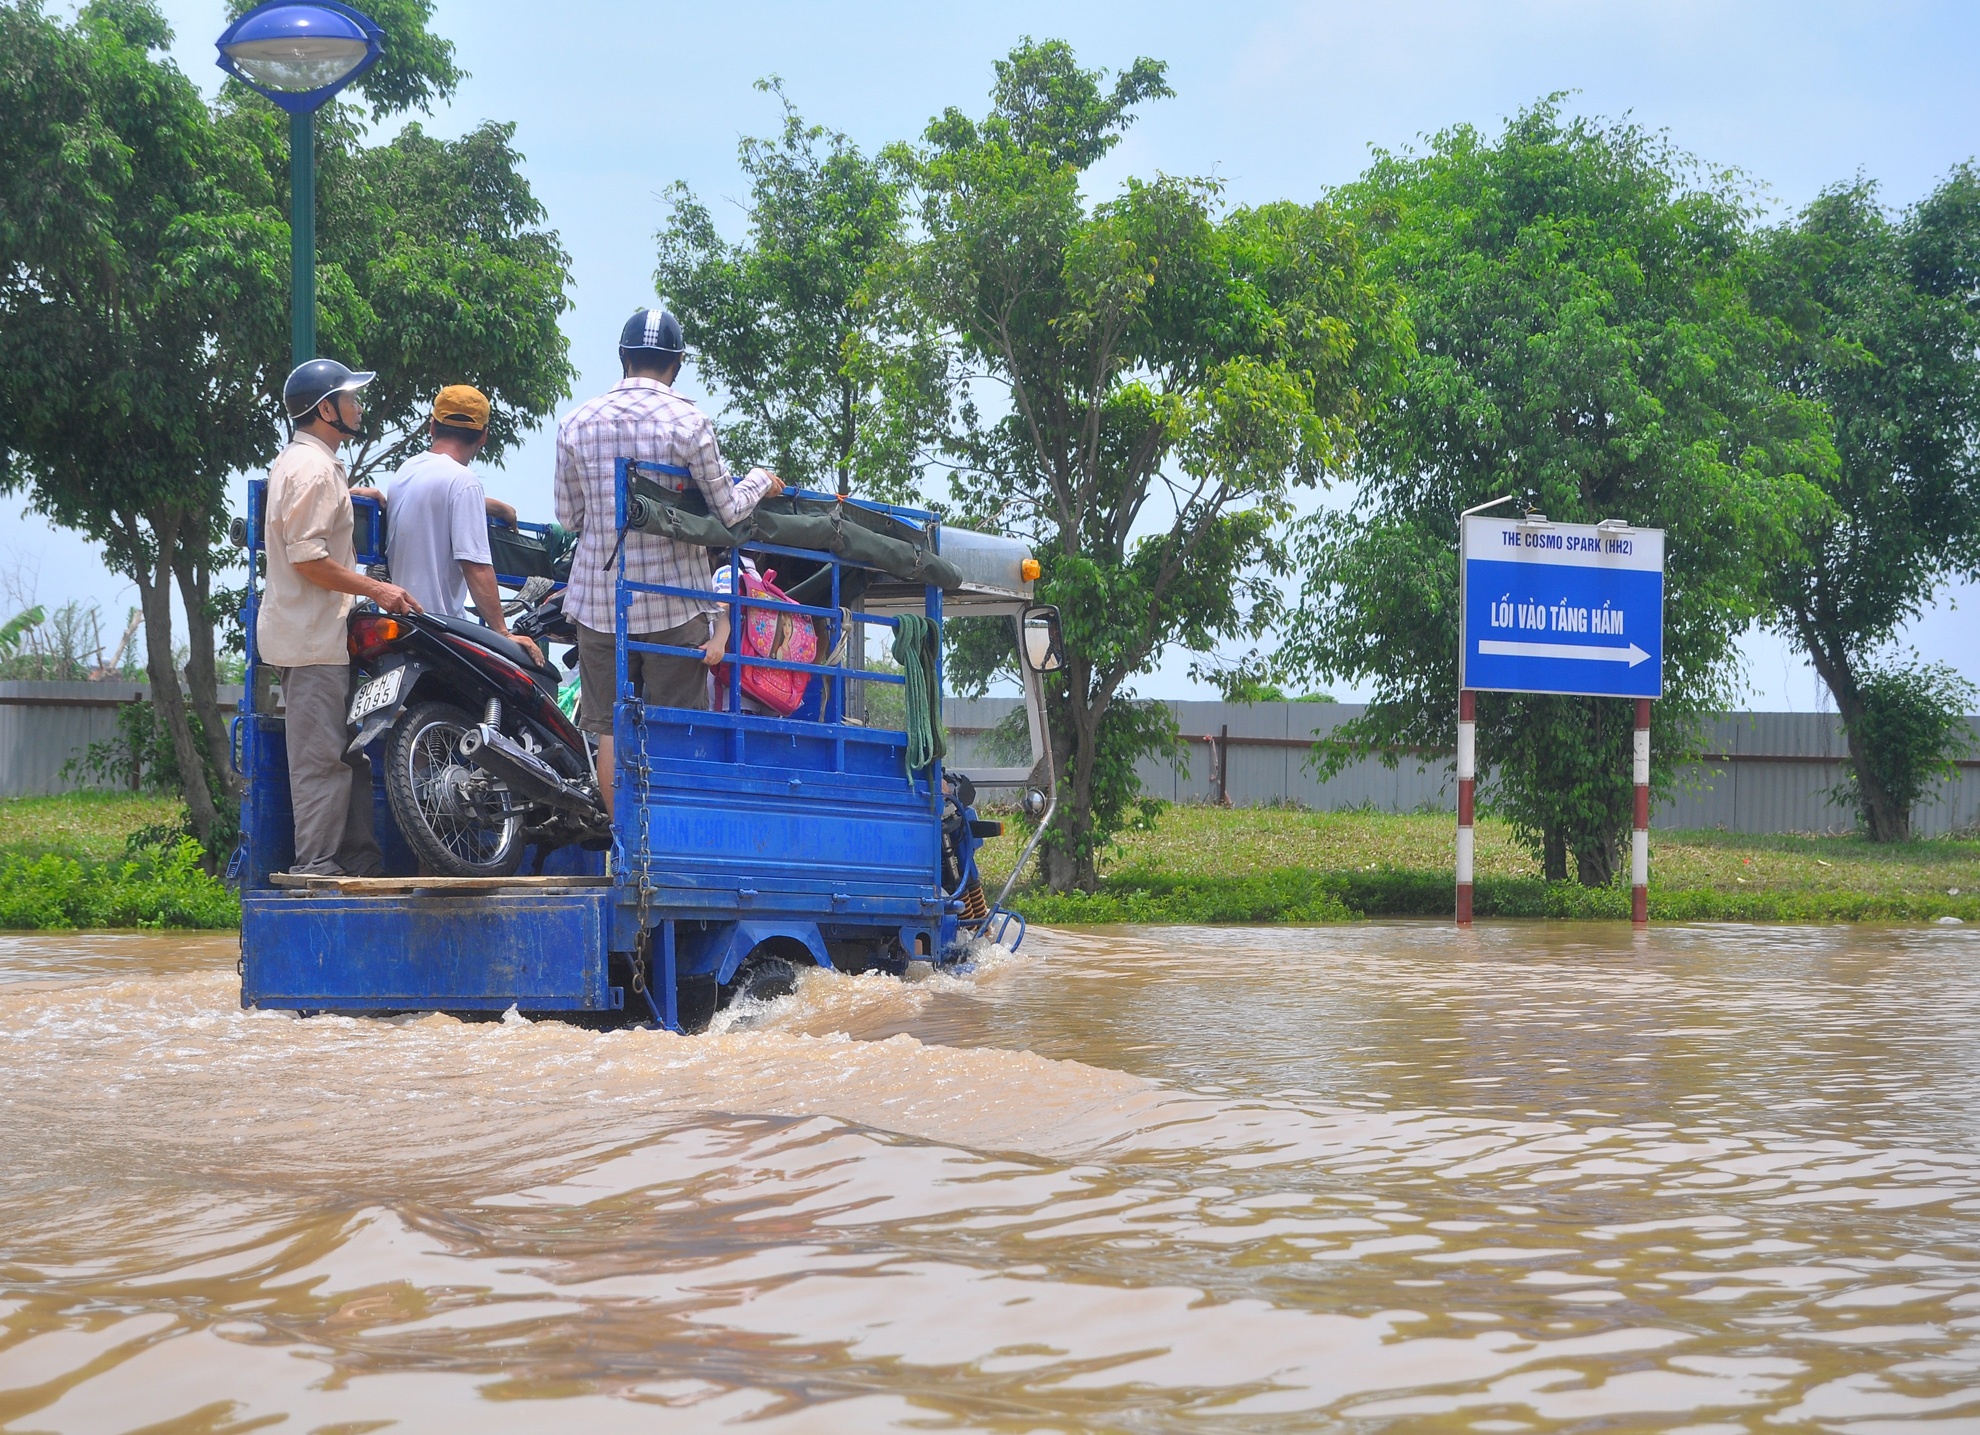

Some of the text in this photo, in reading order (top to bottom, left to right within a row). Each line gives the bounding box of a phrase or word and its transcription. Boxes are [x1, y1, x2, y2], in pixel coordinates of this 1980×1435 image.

[1502, 531, 1633, 556] THE COSMO SPARK (HH2)
[1491, 593, 1624, 635] LỐI VÀO TẦNG HẦM
[355, 688, 391, 717] 5095
